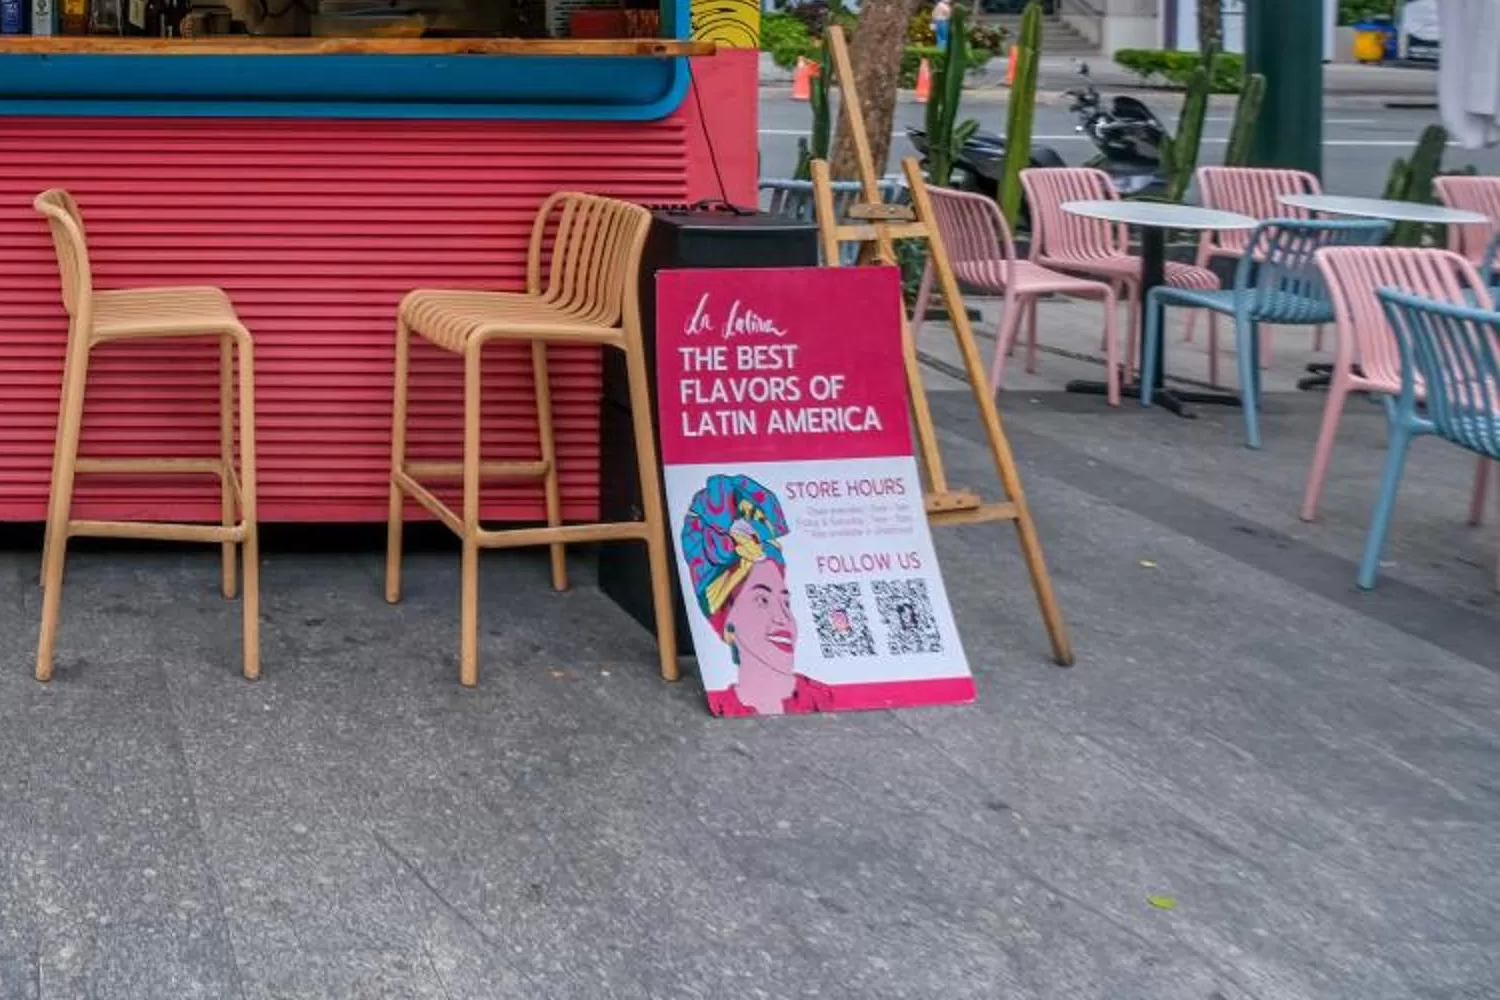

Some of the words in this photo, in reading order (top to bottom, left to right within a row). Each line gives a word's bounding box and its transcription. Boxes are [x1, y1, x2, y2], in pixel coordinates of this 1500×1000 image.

[677, 346, 728, 371] THE
[736, 344, 798, 370] BEST
[680, 376, 800, 404] FLAVORS
[809, 375, 845, 400] OF
[682, 409, 757, 437] LATIN
[767, 406, 884, 435] AMERICA
[785, 481, 842, 499] STORE
[846, 478, 905, 496] HOURS
[816, 552, 890, 573] FOLLOW
[897, 551, 921, 569] US
